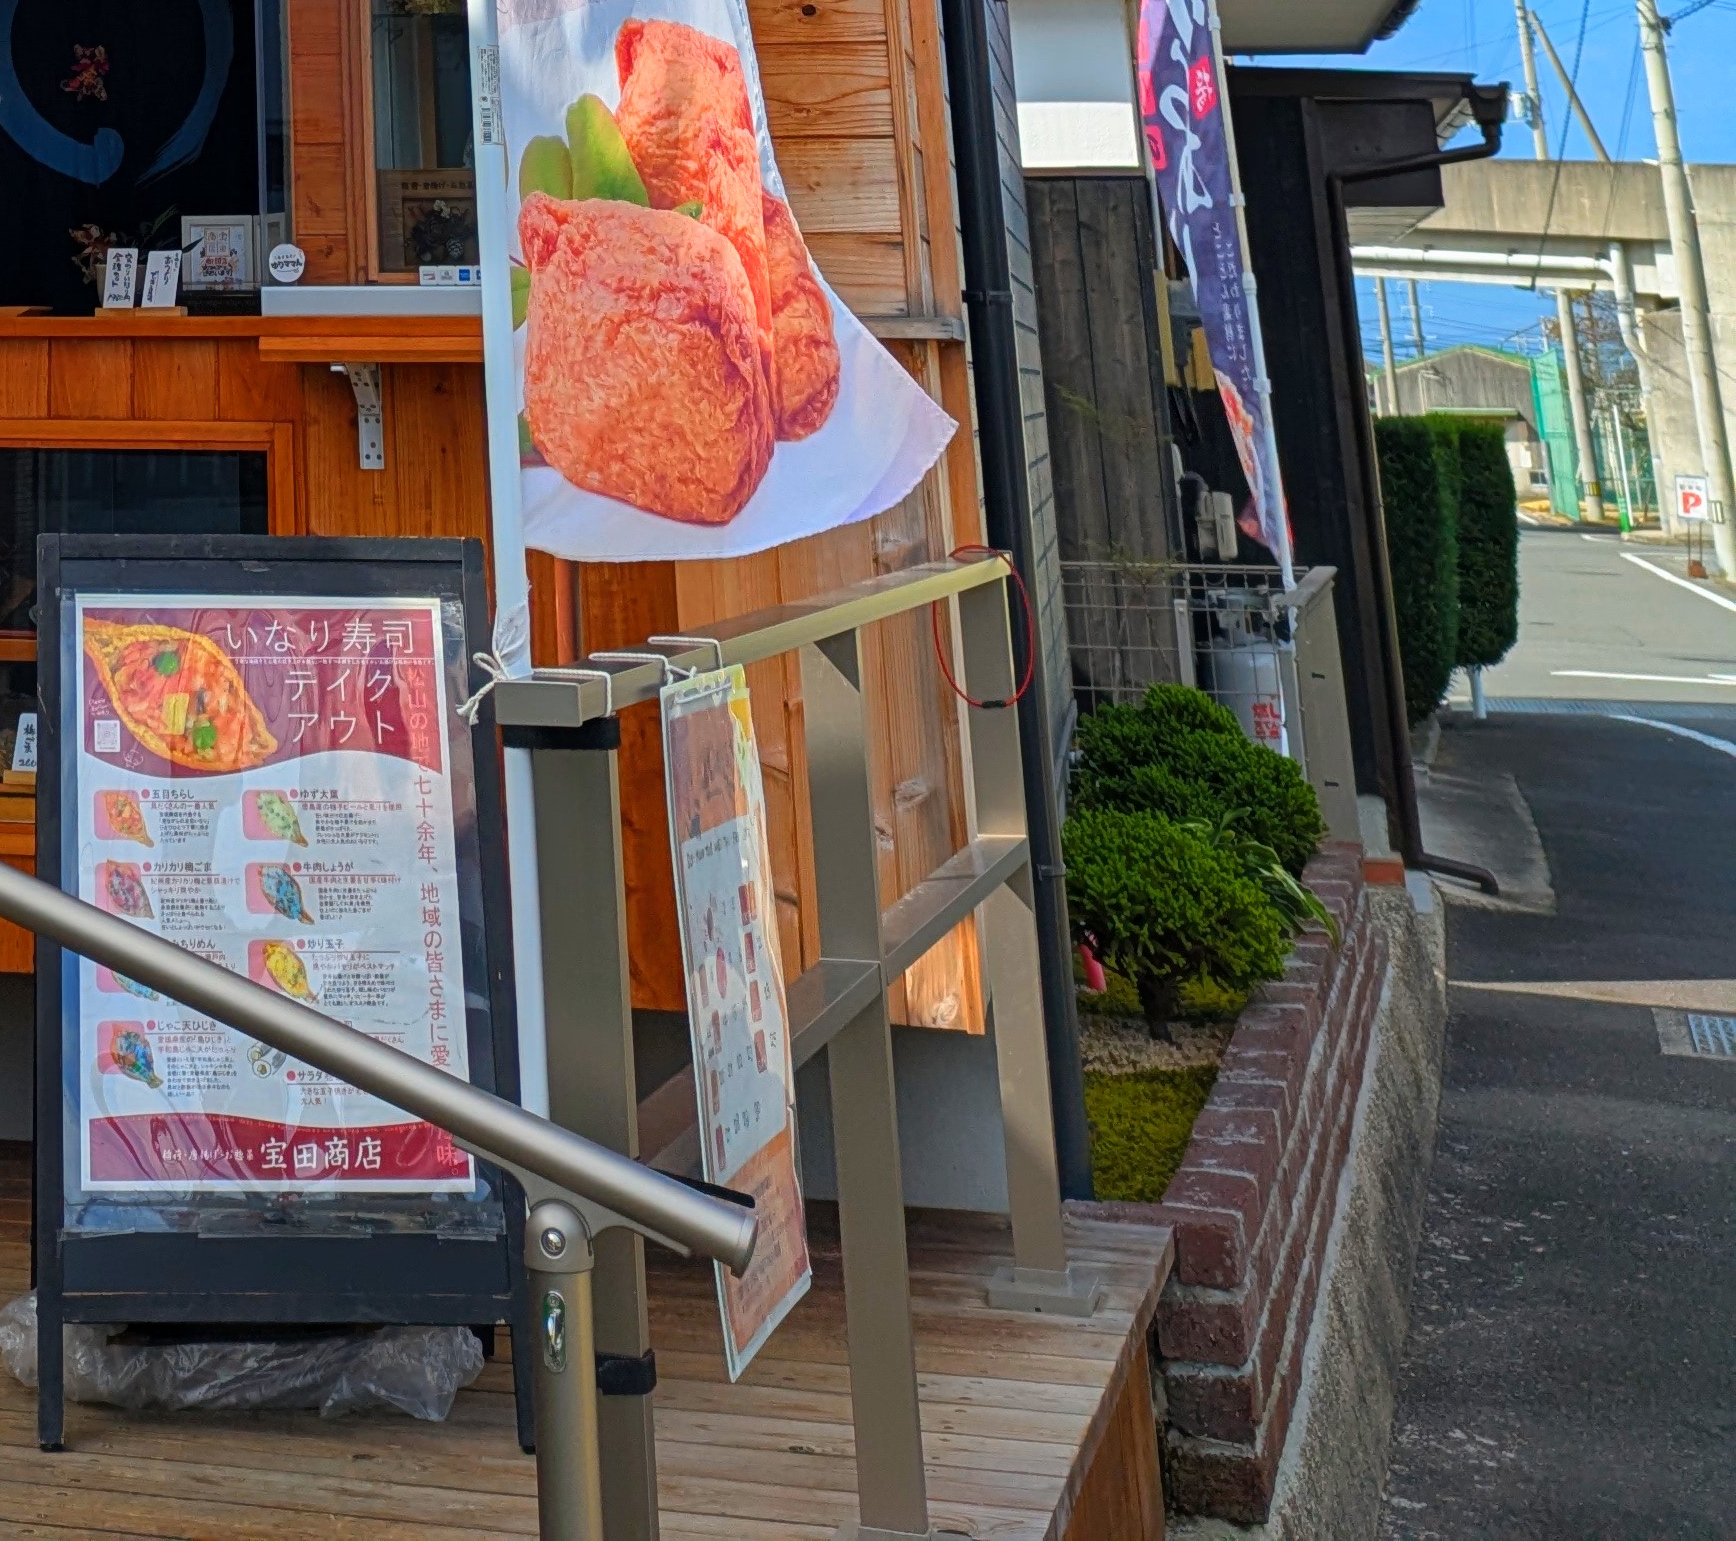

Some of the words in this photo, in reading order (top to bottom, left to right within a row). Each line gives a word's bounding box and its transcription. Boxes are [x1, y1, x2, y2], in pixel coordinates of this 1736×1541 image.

[1682, 491, 1701, 514] P
[227, 617, 413, 654] いなり寿司
[285, 668, 392, 702] テイク
[288, 710, 394, 744] アウト
[152, 789, 195, 799] 五目ちらし
[300, 789, 339, 799] ゆず大葉
[153, 862, 212, 872] カリカリ梅ごま
[303, 862, 354, 872] 牛肉しょうが
[307, 939, 344, 949] 炒り玉子
[157, 1020, 217, 1031] じゃこ天ひじき
[260, 1136, 383, 1171] 宝田商店
